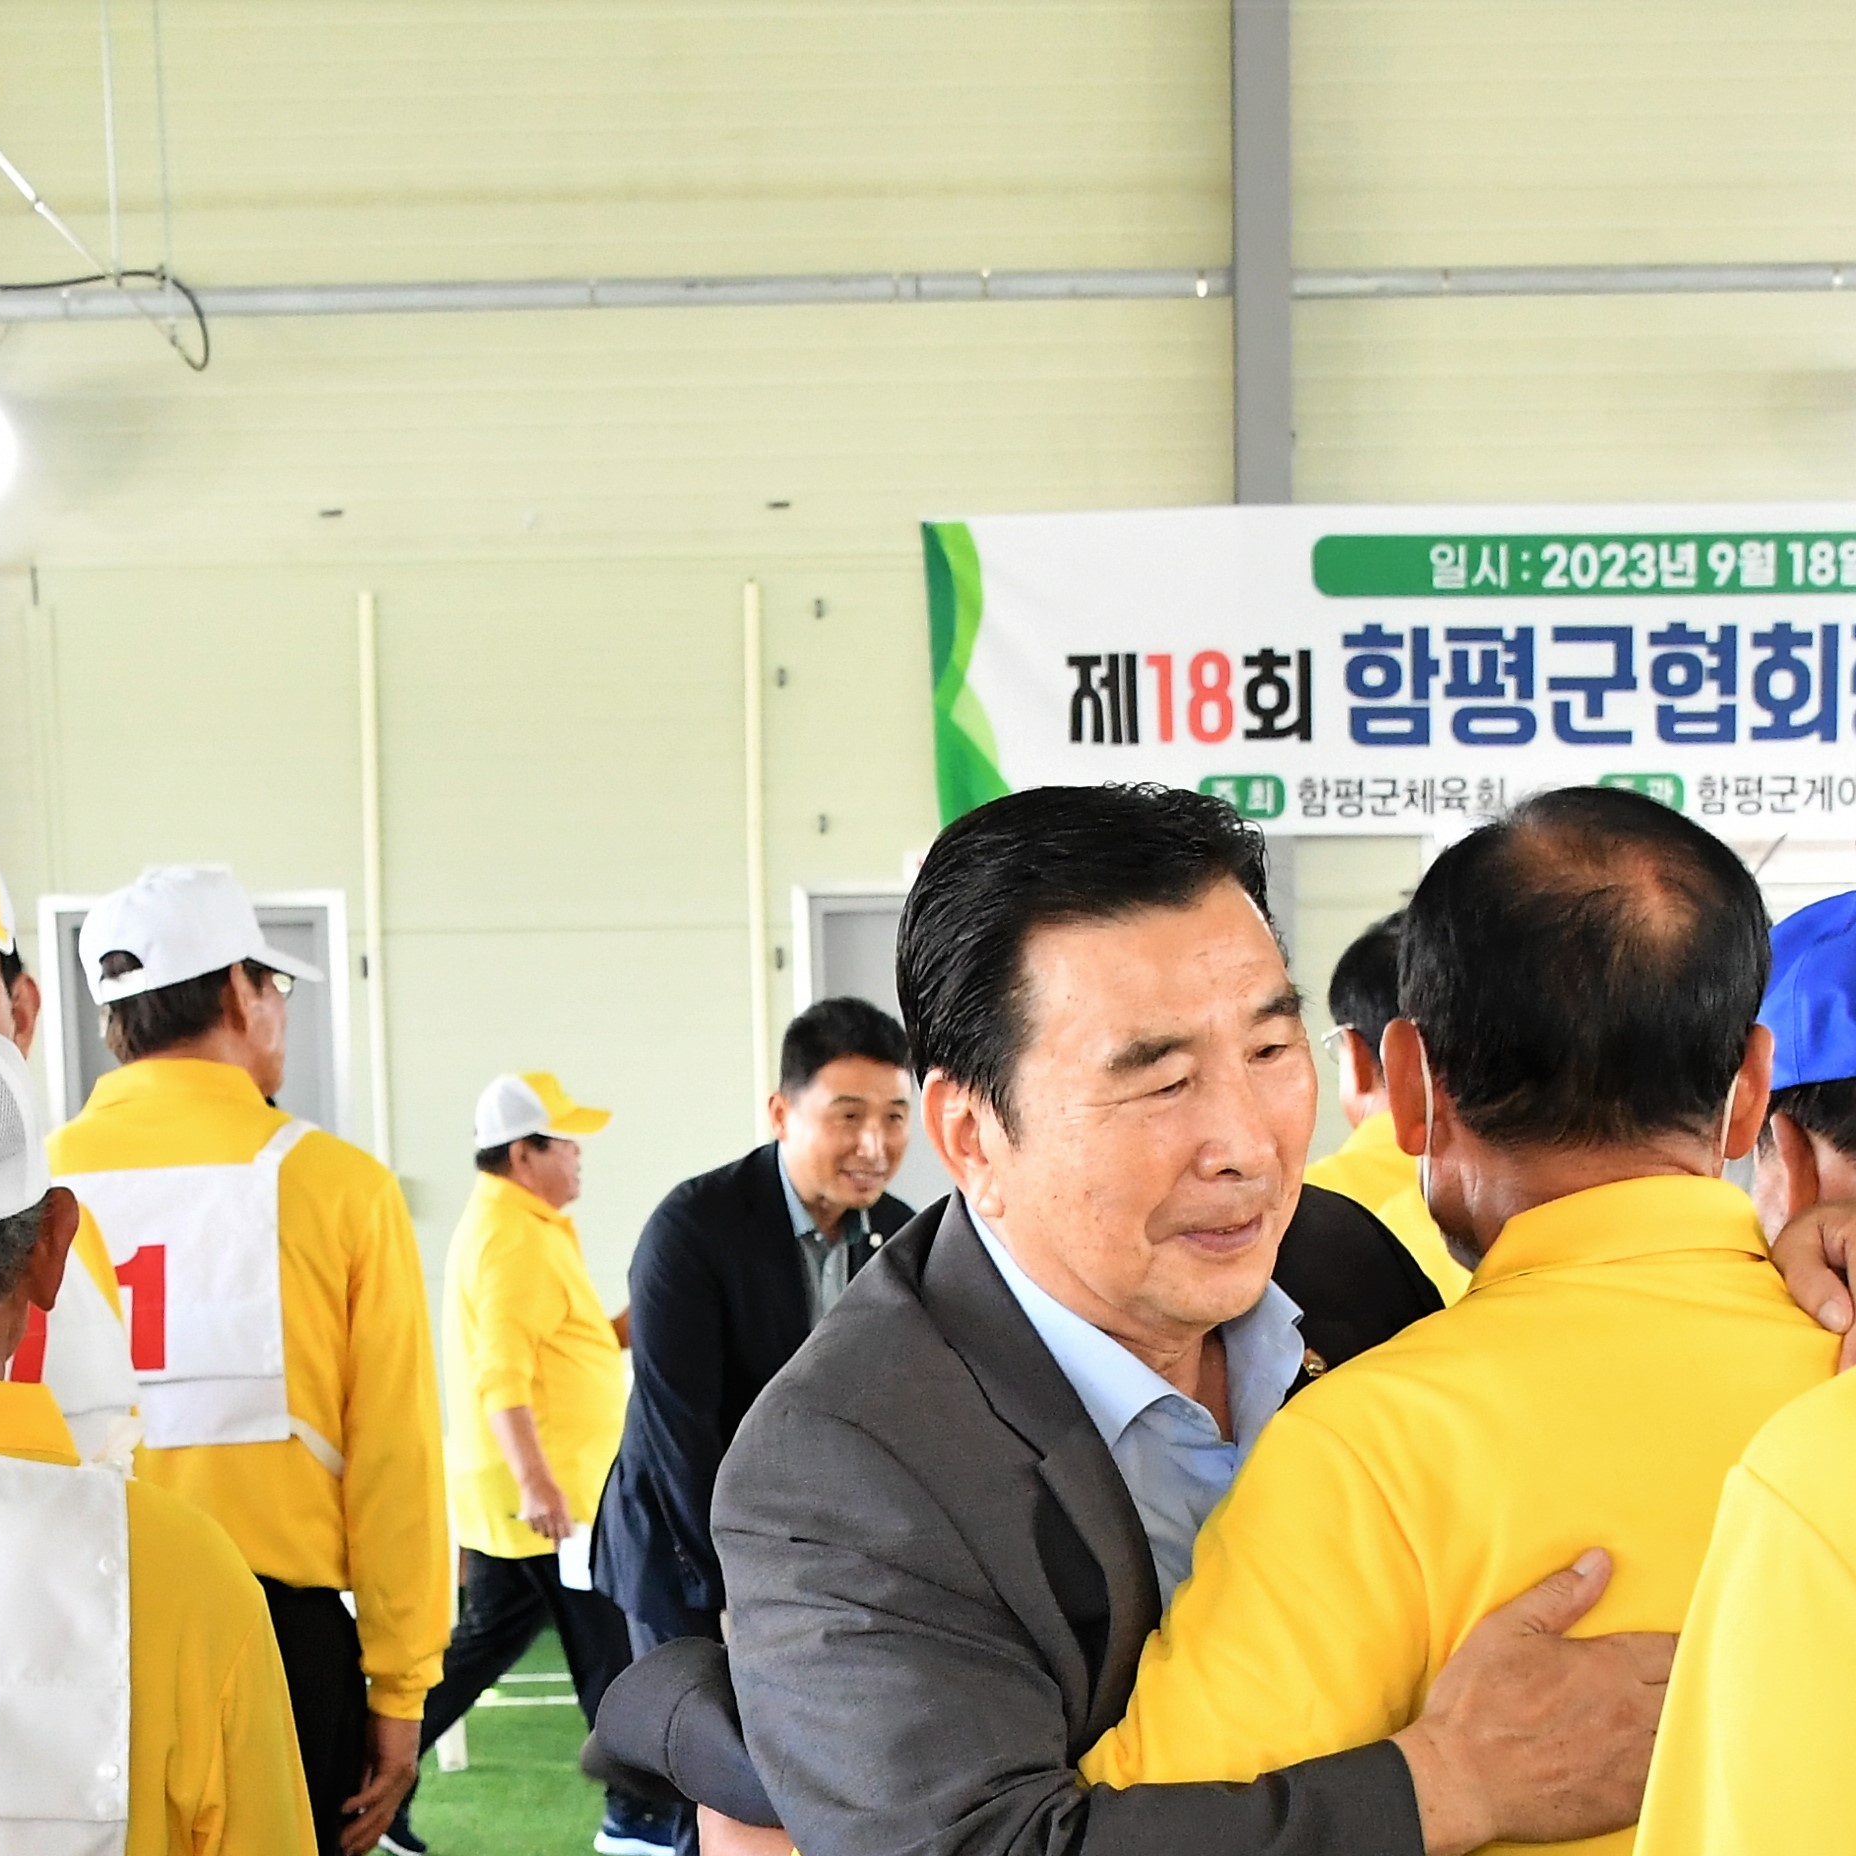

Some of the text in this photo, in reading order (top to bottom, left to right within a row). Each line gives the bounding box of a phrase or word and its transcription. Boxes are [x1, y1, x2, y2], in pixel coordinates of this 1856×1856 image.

[1429, 542, 1509, 589] 일시
[1540, 541, 1698, 588] 2023년
[1707, 540, 1777, 587] 9월
[1066, 647, 1313, 746] 제18회
[1297, 776, 1505, 818] 함평군체육회
[116, 1244, 166, 1372] 1
